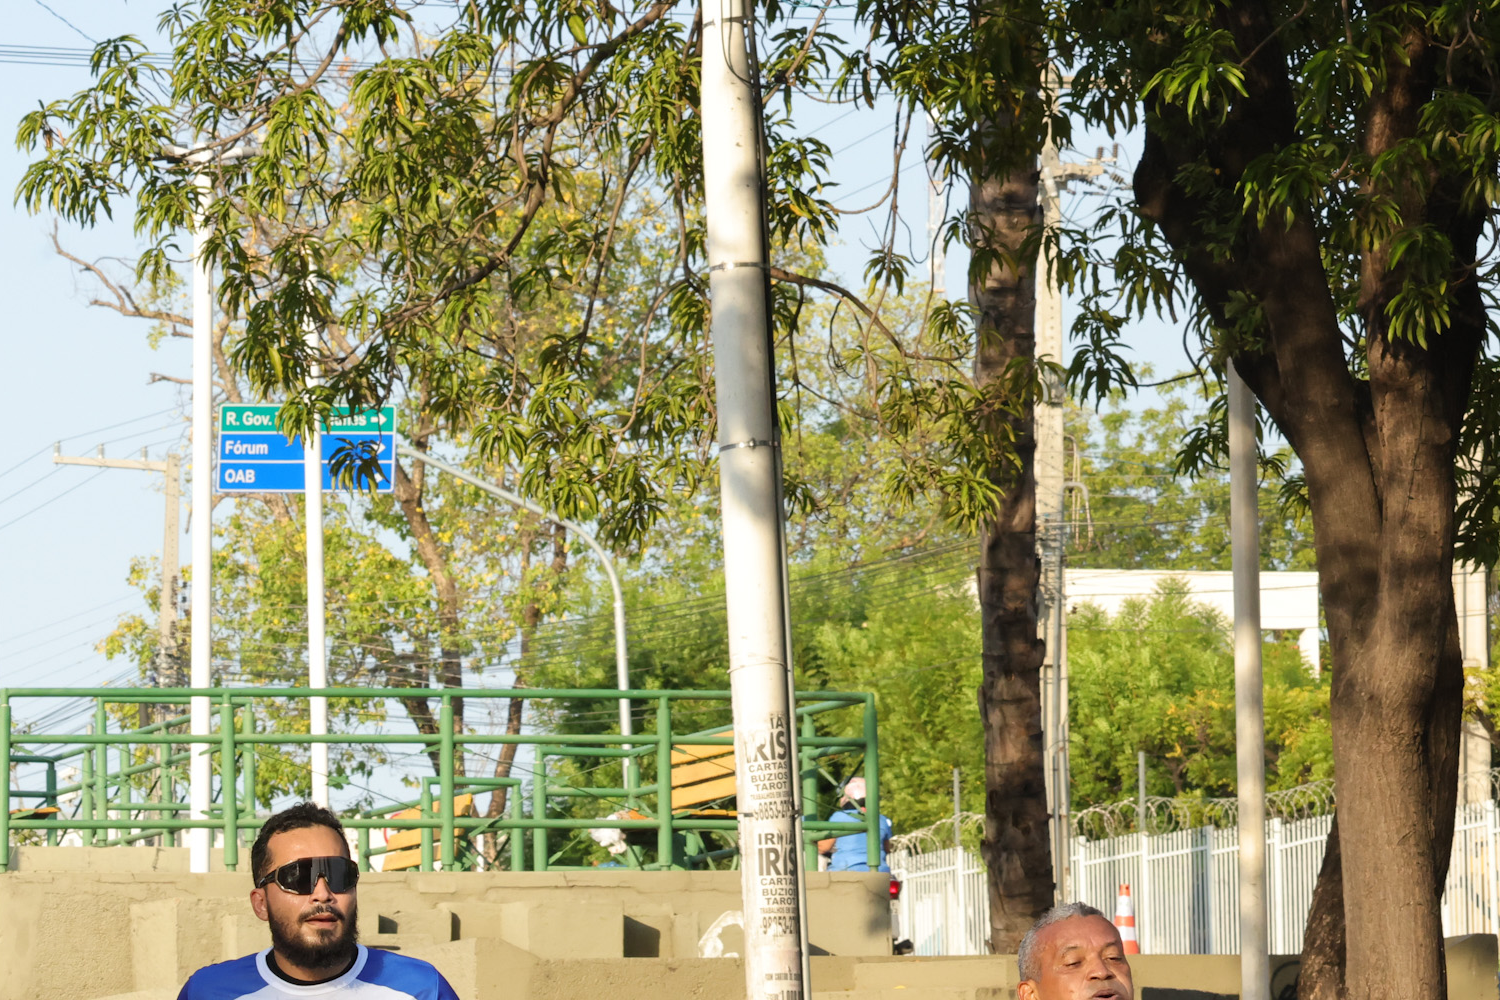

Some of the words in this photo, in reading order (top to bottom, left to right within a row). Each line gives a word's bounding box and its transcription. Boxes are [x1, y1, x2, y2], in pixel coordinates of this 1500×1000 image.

[226, 411, 240, 426] R.
[242, 411, 272, 426] Gov.
[225, 440, 269, 455] Fórum
[225, 469, 256, 484] OAB
[748, 760, 788, 773] CARTAS
[754, 780, 787, 792] TAROT
